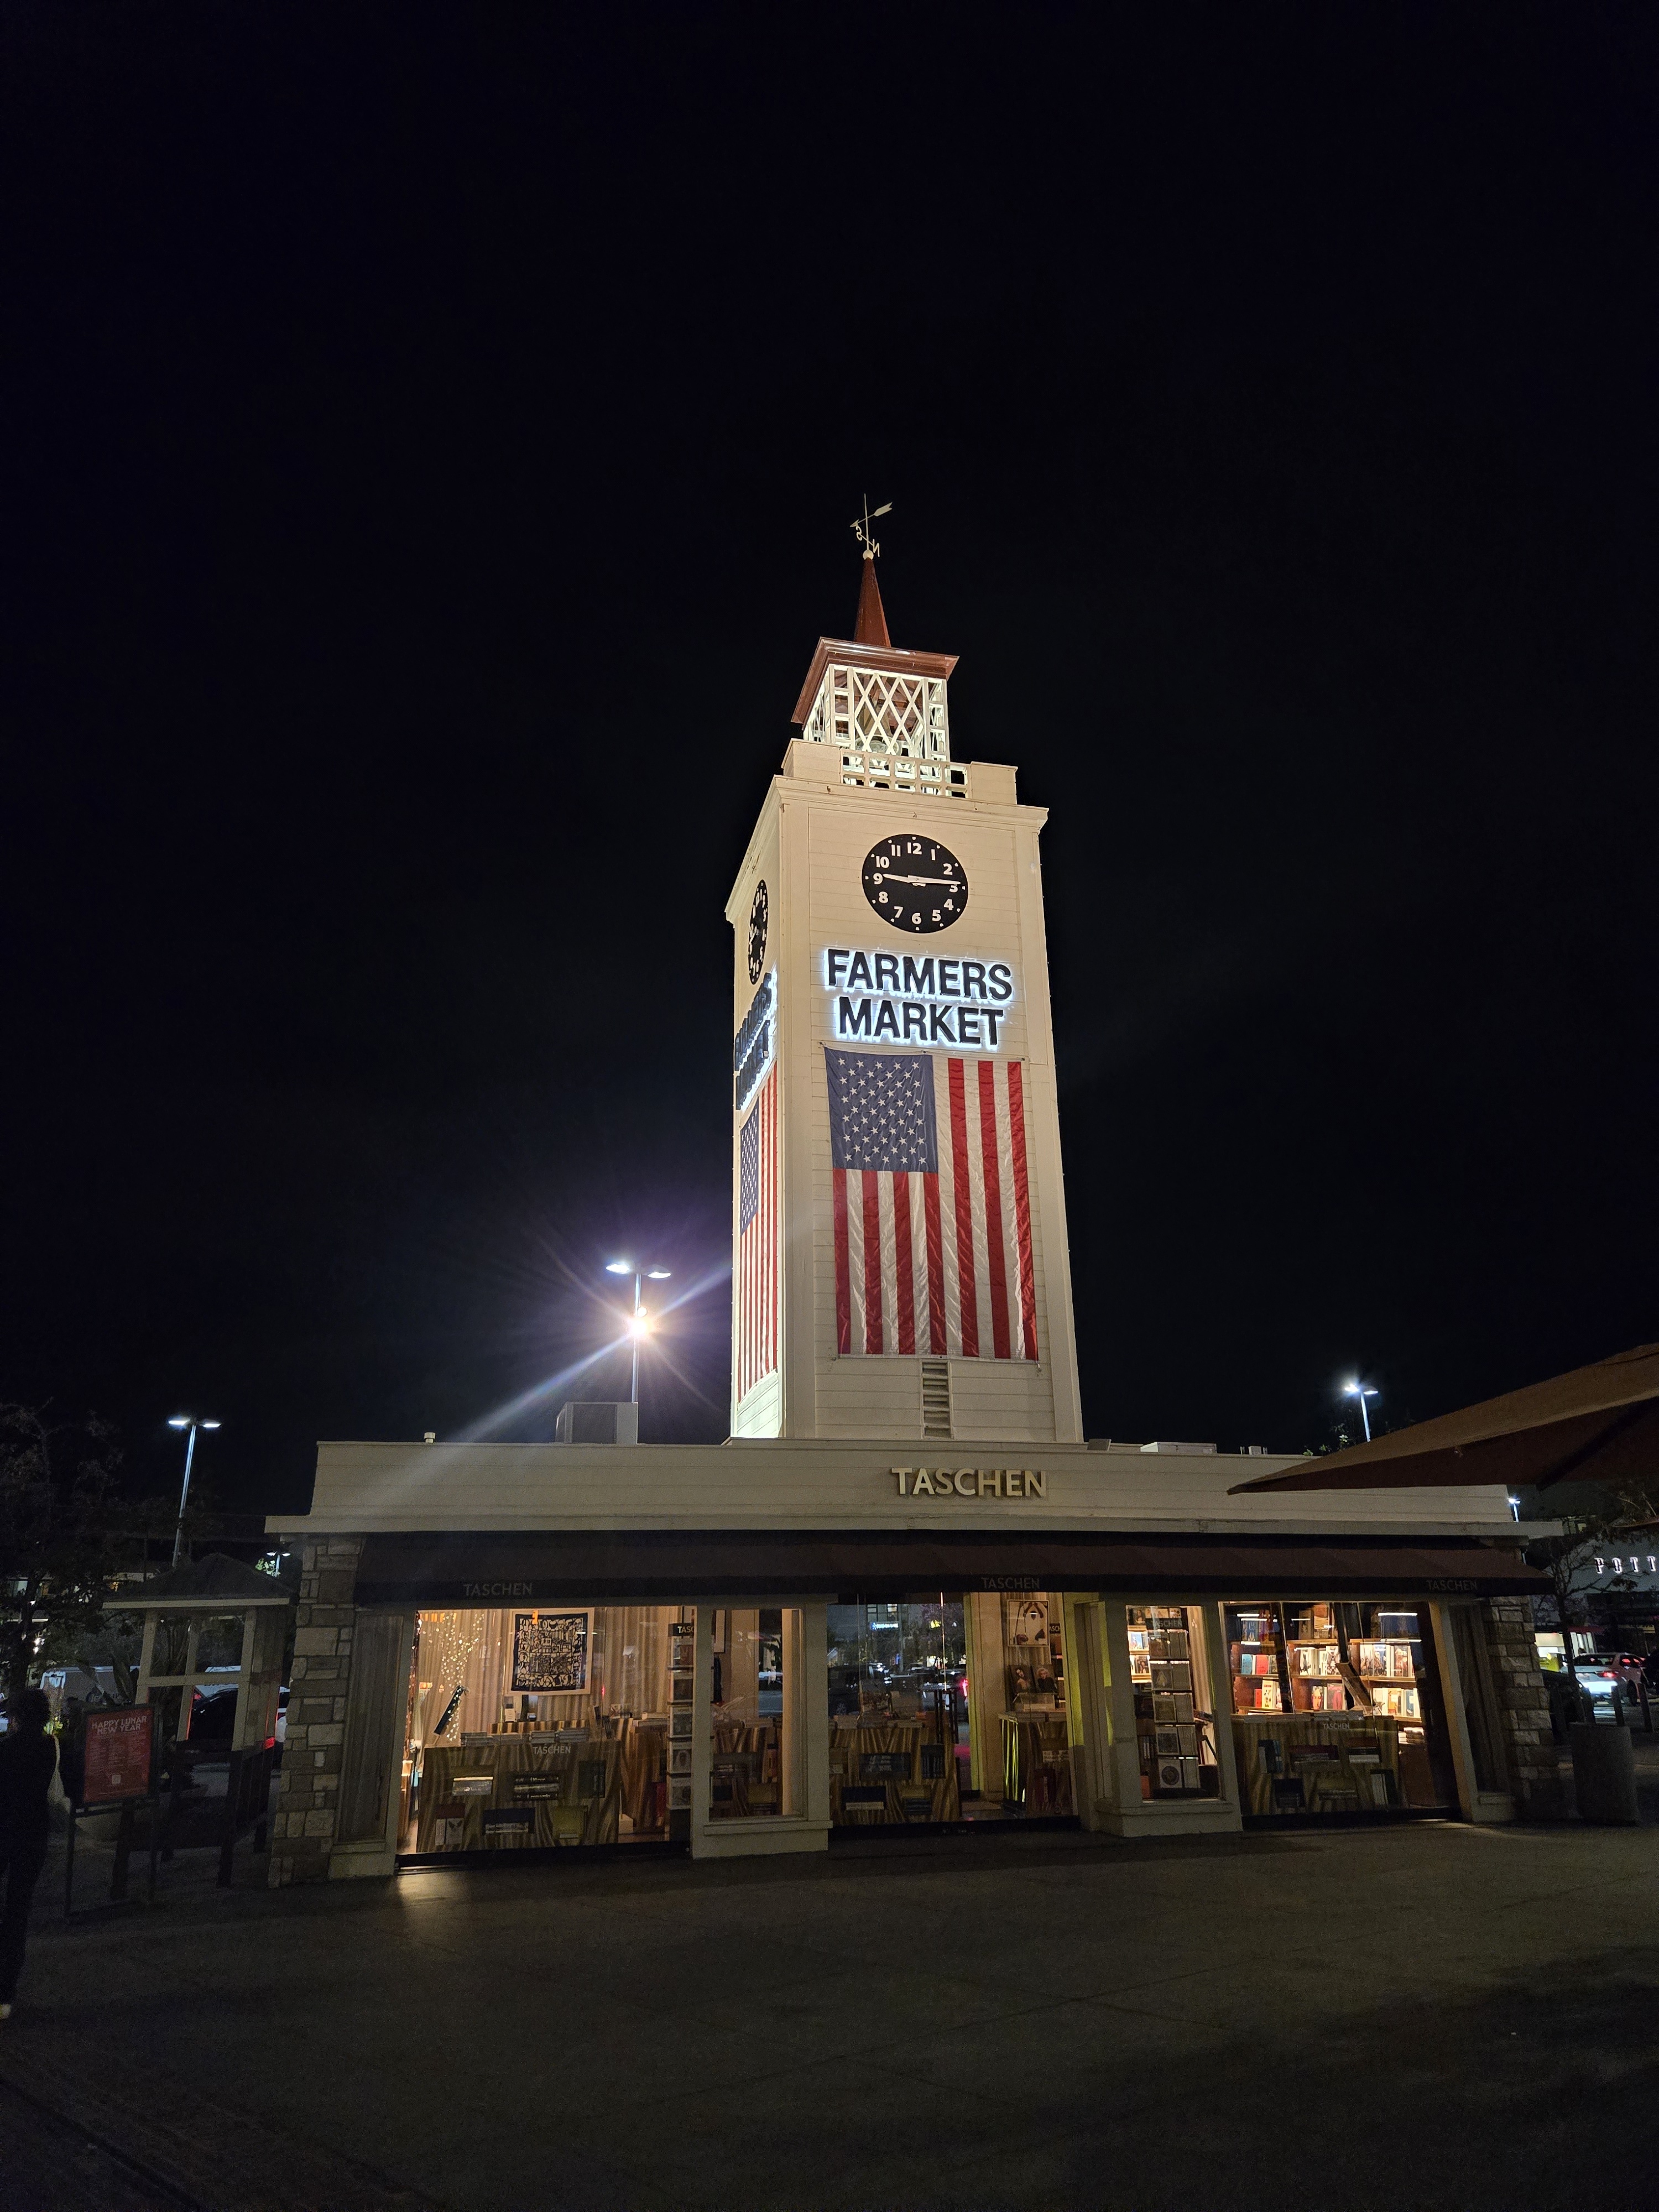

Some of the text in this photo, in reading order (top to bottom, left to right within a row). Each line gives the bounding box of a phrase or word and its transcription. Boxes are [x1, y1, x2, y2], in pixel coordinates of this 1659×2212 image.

[891, 844, 901, 857] 11
[907, 842, 922, 854] 12
[931, 849, 936, 860] 1
[875, 855, 890, 868] 10
[943, 863, 953, 875] 2
[873, 873, 883, 885] 9
[878, 891, 889, 903] 8
[943, 899, 954, 911] 4
[894, 906, 904, 918] 7
[932, 909, 941, 921] 5
[911, 913, 922, 925] 6
[827, 948, 1013, 1001] FARMERS
[838, 996, 1004, 1046] MARKET
[891, 1468, 1047, 1497] TASCHEN
[1594, 1556, 1657, 1574] POTT
[980, 1577, 1040, 1589] TASCHEN
[1426, 1579, 1478, 1592] TASCHEN
[462, 1583, 533, 1597] TASCHEN
[92, 1715, 148, 1729] HAPPY LUNAR
[1322, 1723, 1350, 1731] TASCHEN
[97, 1723, 142, 1735] NEW YEAR
[533, 1745, 571, 1755] TASCHEN
